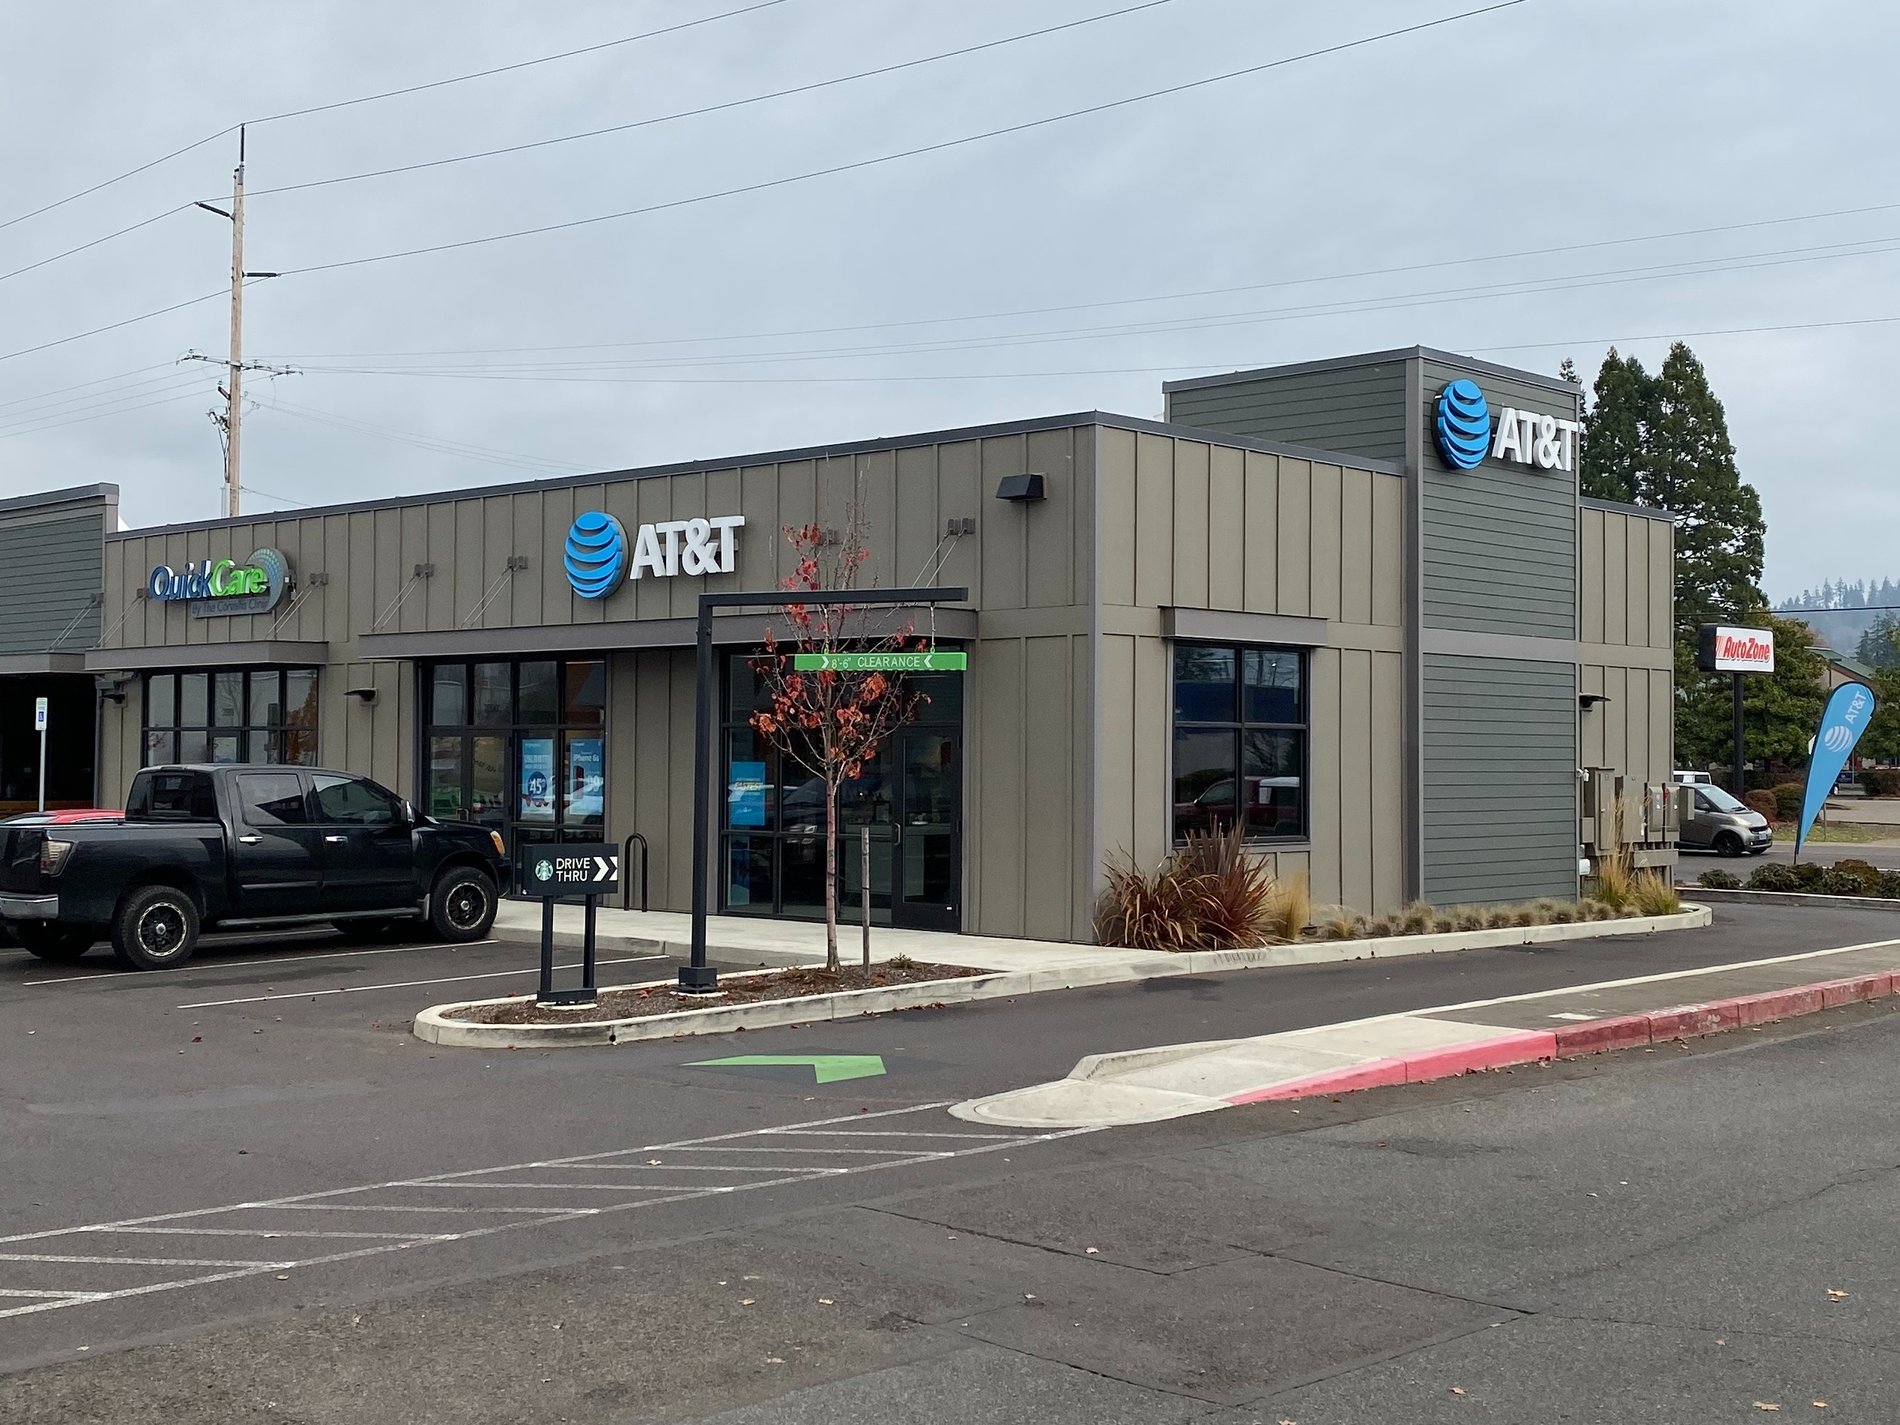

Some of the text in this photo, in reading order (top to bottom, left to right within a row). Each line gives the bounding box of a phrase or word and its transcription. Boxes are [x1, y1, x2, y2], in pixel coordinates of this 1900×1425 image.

[1491, 407, 1580, 472] AT&T
[629, 515, 746, 580] AT&T
[149, 558, 270, 601] QuickCare
[857, 656, 920, 668] CLEARANCE
[1723, 636, 1770, 662] AutoZone
[1844, 690, 1867, 725] AT&T
[556, 857, 591, 870] DRIVE
[556, 870, 588, 882] THRU
